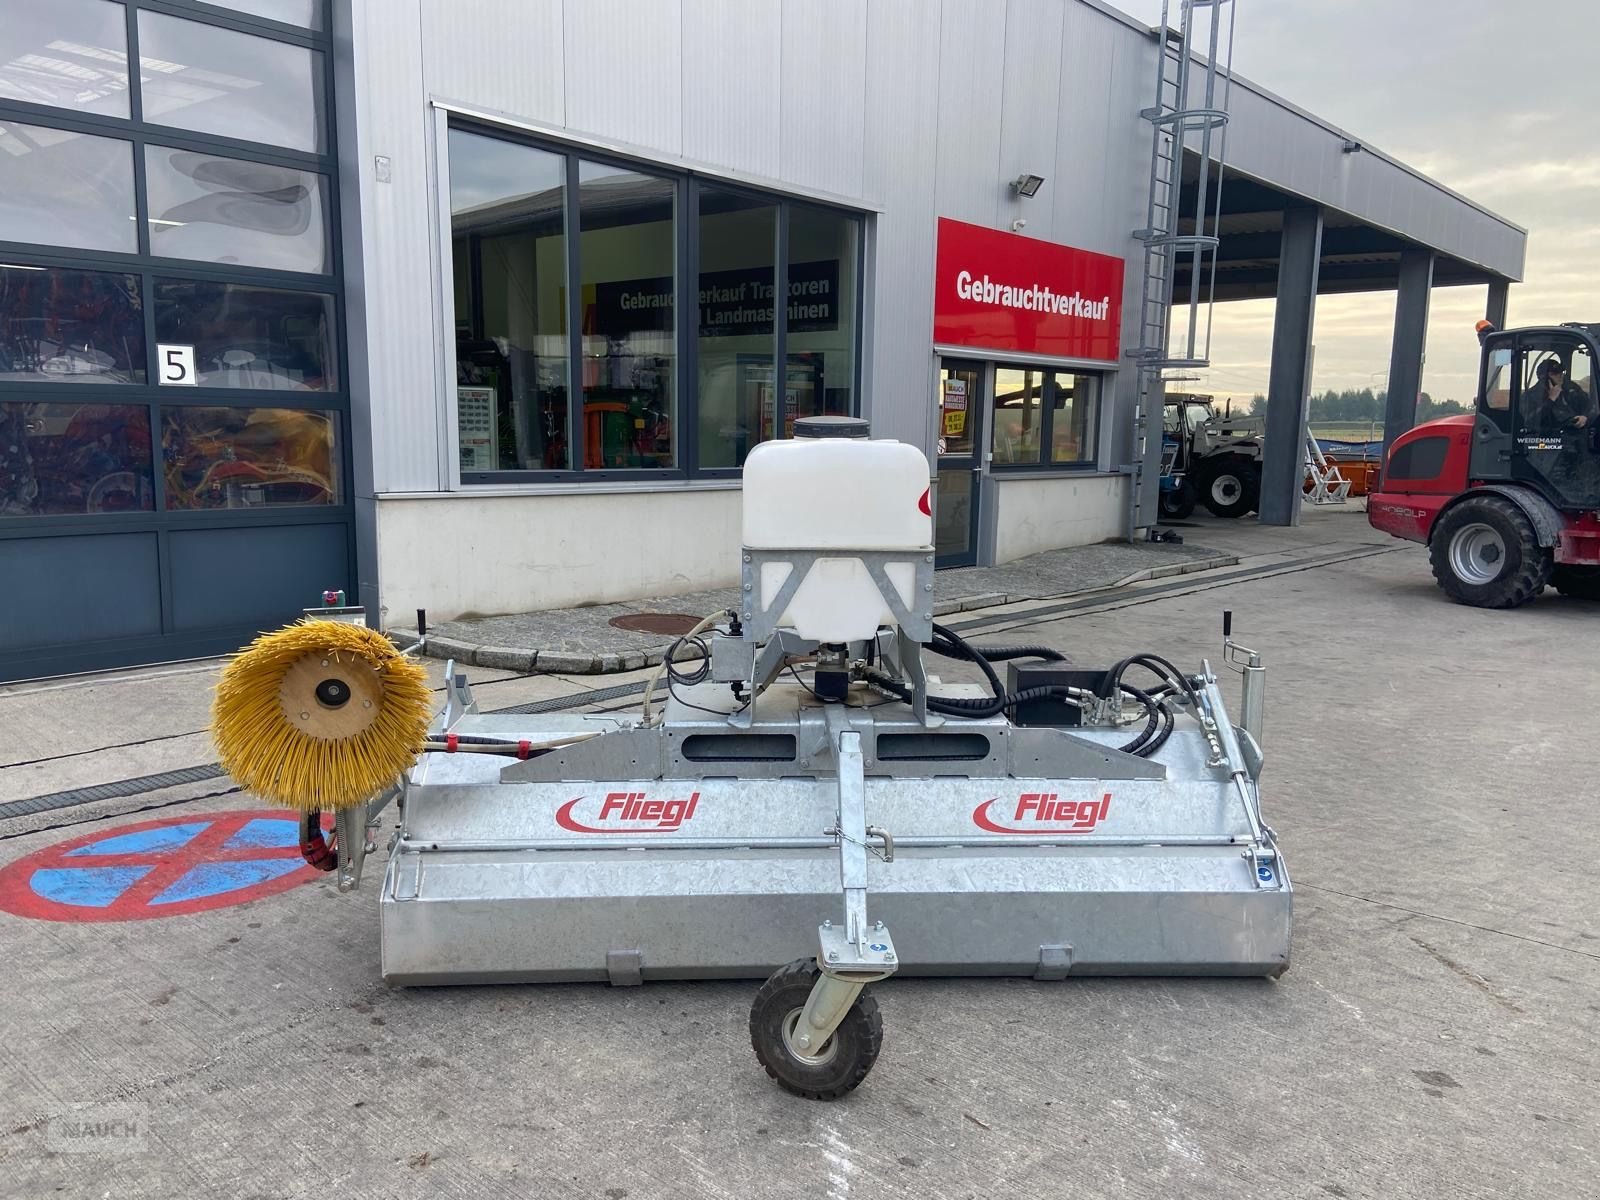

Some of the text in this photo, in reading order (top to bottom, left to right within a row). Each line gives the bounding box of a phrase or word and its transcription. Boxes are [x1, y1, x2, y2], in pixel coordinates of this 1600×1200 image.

[750, 279, 829, 300] Tratoren
[956, 270, 1109, 321] Gebrauchtverkauf
[706, 301, 829, 325] Landmasinen
[166, 350, 186, 381] 5
[598, 792, 701, 827] Fliegl
[1014, 793, 1112, 828] Fliegl
